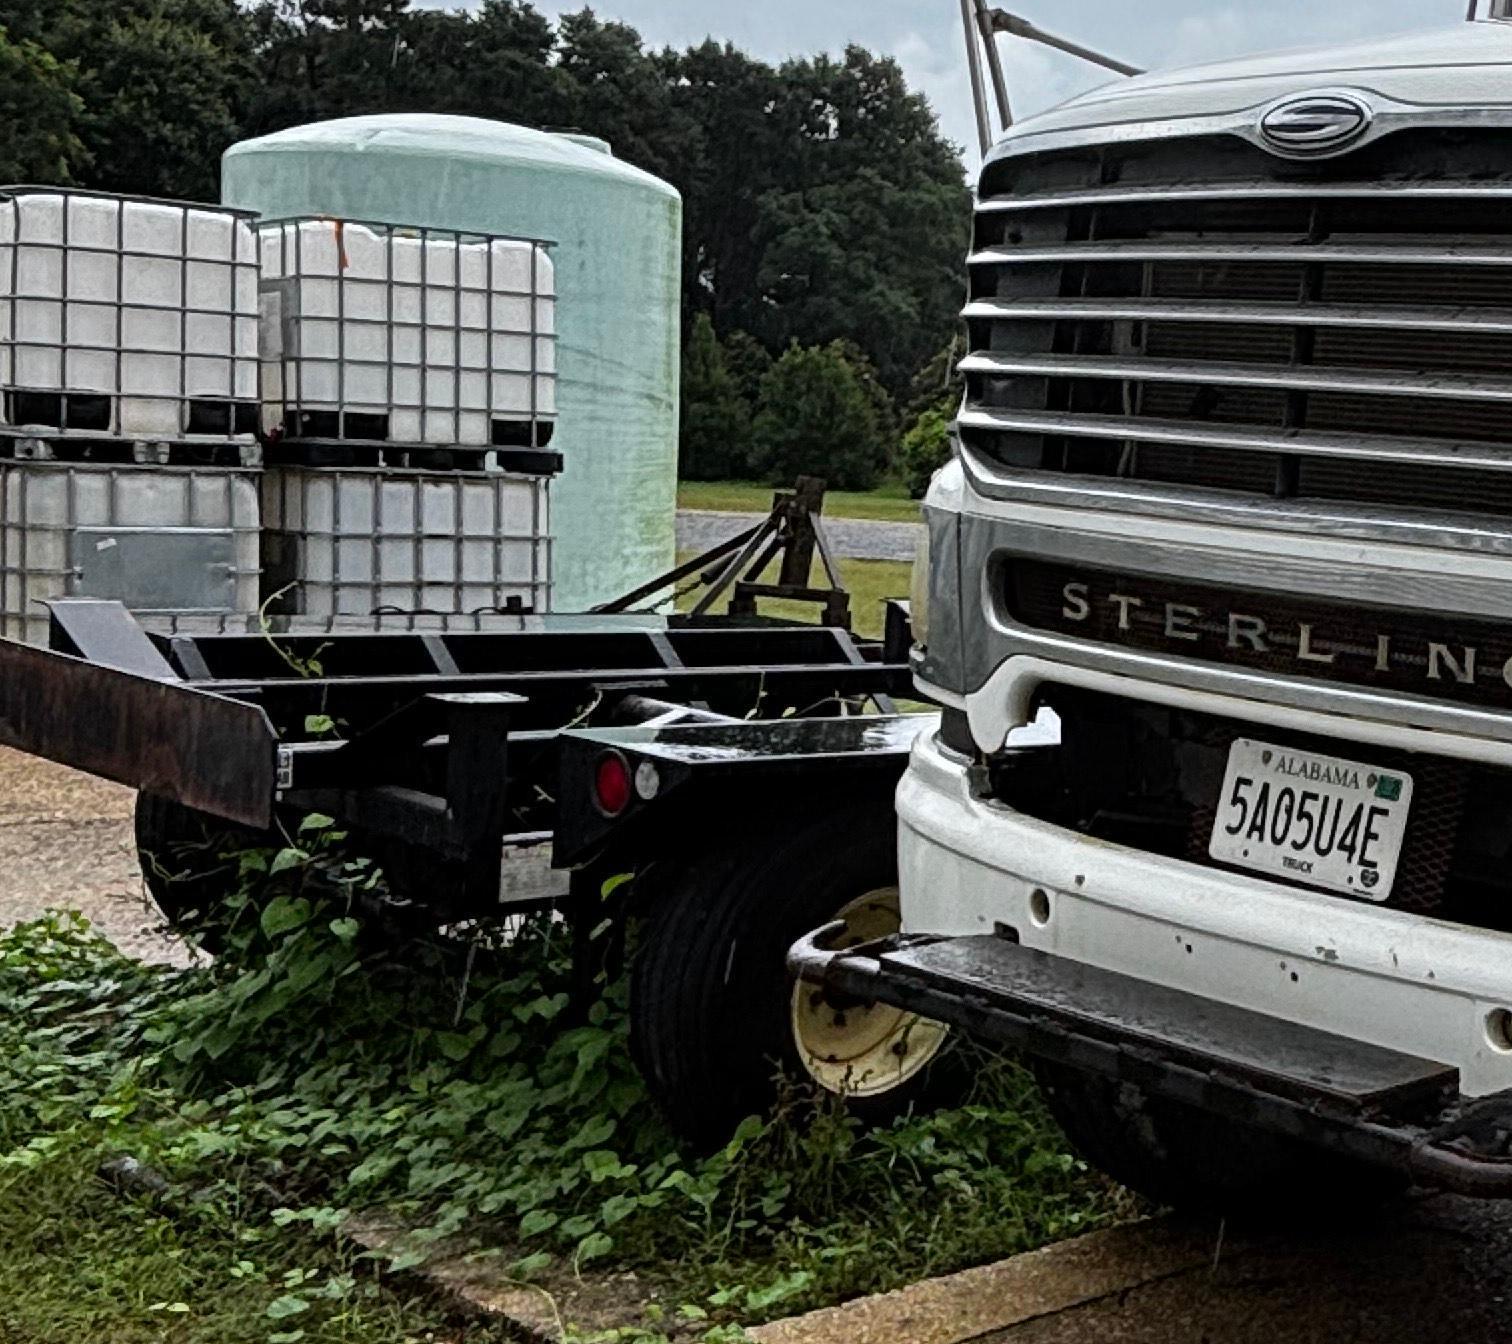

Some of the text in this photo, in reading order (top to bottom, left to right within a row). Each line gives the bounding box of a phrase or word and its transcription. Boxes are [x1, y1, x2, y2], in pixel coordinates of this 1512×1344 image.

[1274, 755, 1360, 790] ALABAMA
[1224, 775, 1390, 869] 5A05U4E
[1282, 856, 1314, 874] TRUCK
